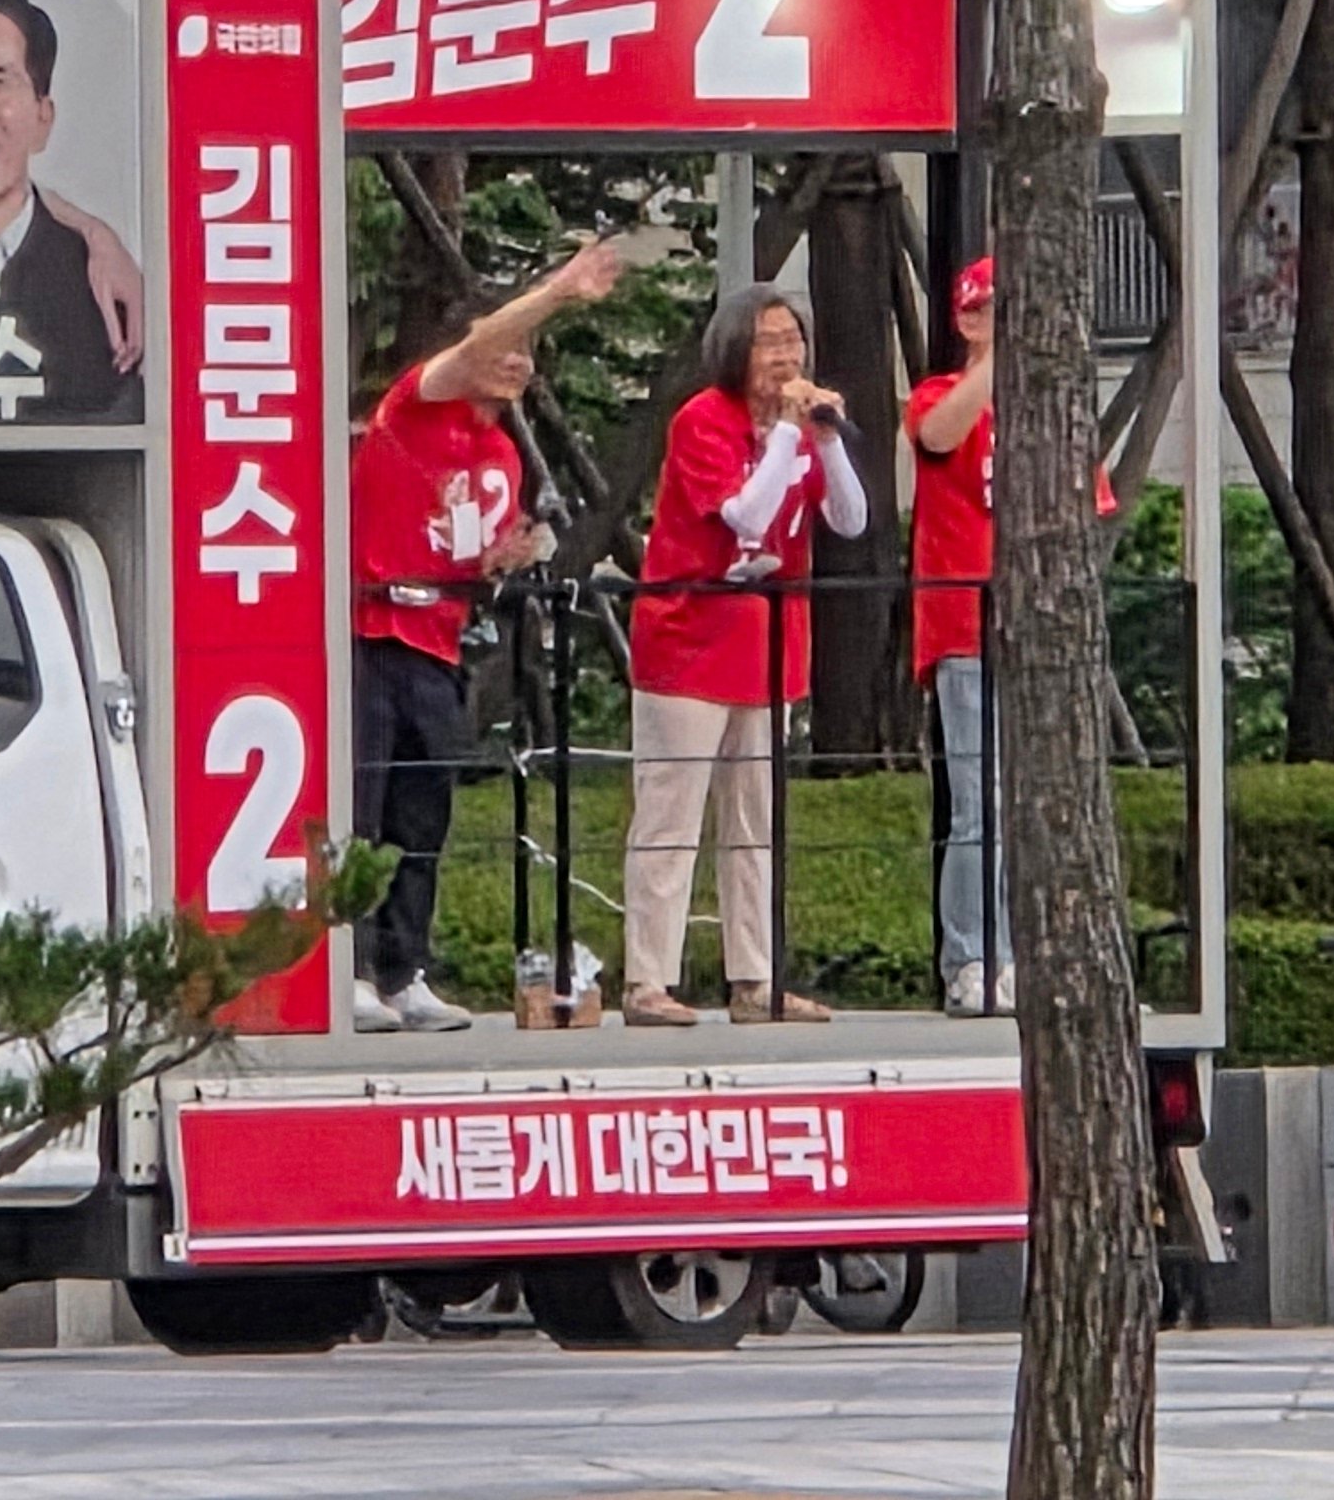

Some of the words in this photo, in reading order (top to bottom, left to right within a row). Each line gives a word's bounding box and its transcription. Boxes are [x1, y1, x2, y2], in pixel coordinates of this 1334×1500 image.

[198, 144, 298, 606] 김문수
[203, 694, 308, 913] 2
[396, 1113, 578, 1201] 새롭게
[588, 1106, 848, 1196] 대한민국!
